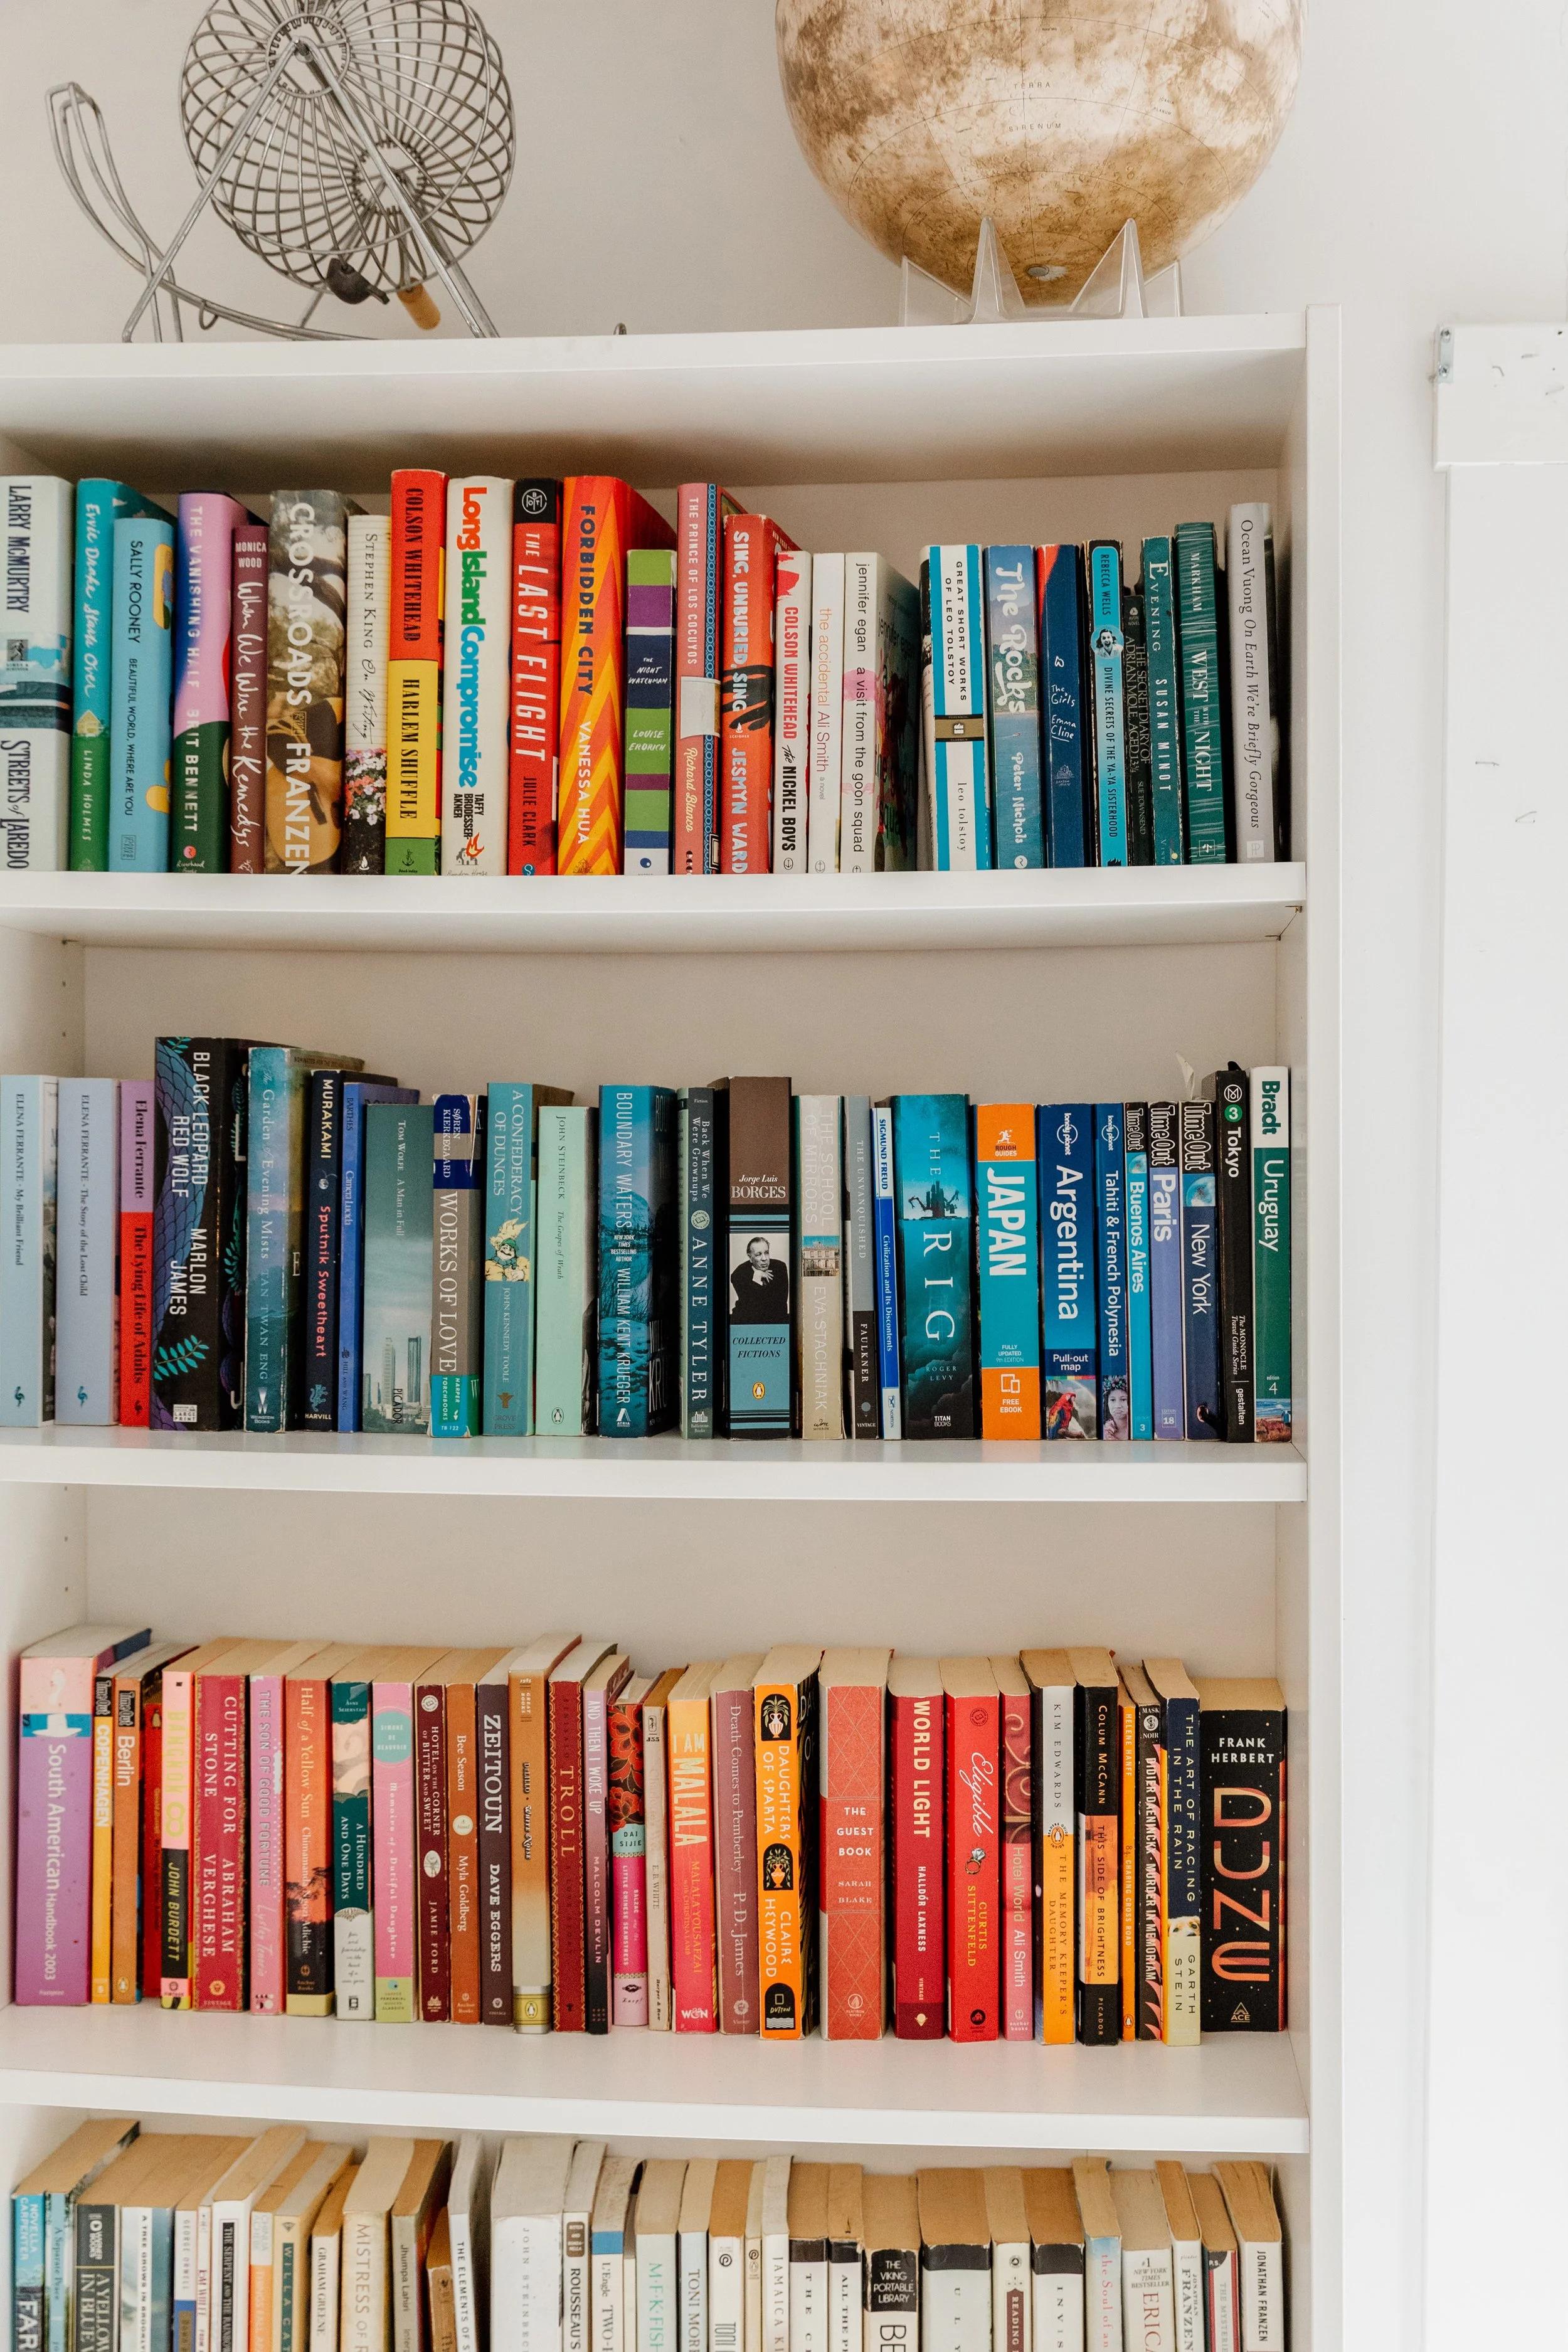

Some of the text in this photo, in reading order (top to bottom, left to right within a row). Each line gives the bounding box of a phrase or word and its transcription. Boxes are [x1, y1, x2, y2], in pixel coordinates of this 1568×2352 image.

[1014, 82, 1051, 90] TERRA
[1009, 123, 1061, 132] SIRENUM
[7, 485, 30, 529] LARRY
[235, 543, 267, 553] MONICA
[237, 558, 262, 568] WOOD
[945, 578, 952, 594] OF
[1239, 519, 1256, 615] Ocean Vuong
[127, 541, 143, 643] SALLY ROONEY
[287, 502, 315, 704] CROSSROADS
[578, 506, 595, 696] FORBIDDEN CITY
[731, 531, 749, 712] SING, UNBURIED, SING
[854, 563, 870, 652] jennifer egan
[956, 562, 967, 701] GREAT SHORT WORKS
[400, 488, 424, 819] COLSON WHITEHEAD HARLEM SHUFFLE
[515, 533, 549, 762] THE LAST FLIGHT
[946, 630, 955, 686] TOLSTOY
[995, 563, 1032, 714] The Rocks
[781, 607, 798, 851] COLSON WHITEHEAD The NICKEL BOYS
[816, 608, 832, 771] the accidental Ali Smith
[453, 793, 464, 818] AKNER
[462, 794, 474, 840] BRODESSER-
[474, 794, 484, 815] TAFFY
[577, 722, 592, 844] VANESSA HUA
[731, 748, 746, 874] JESMYN WARD
[1011, 752, 1025, 844] Peter Nichols
[191, 1052, 209, 1185] BLACK LEOPARD
[319, 1079, 334, 1158] MURAKAMI
[442, 1109, 451, 1178] KIERKEGAARD
[451, 1109, 463, 1139] SØREN
[556, 1116, 567, 1142] JOHN
[1261, 1081, 1281, 1135] Bradt
[172, 1116, 189, 1198] RED WOLF
[615, 1092, 632, 1229] BOUNDARY WATERS
[879, 1119, 889, 1190] SIGMUND FREUD
[928, 1132, 941, 1176] THE
[1224, 1127, 1242, 1177] Tokyo
[731, 1185, 786, 1199] BORGES
[987, 1167, 1027, 1276] JAPAN
[1152, 1173, 1177, 1242] Paris
[1258, 1160, 1283, 1252] Uruguay
[189, 1229, 208, 1295] MARLON
[1050, 1165, 1084, 1320] Argentina
[1130, 1181, 1147, 1293] Buenos Aires
[1190, 1223, 1211, 1315] New York
[169, 1261, 187, 1315] JAMES
[315, 1206, 331, 1357] Sputnik Sweetheart
[440, 1191, 458, 1372] WORKS OF LOVE
[691, 1237, 707, 1402] ANNE TYLER
[922, 1232, 956, 1342] RIG
[737, 1350, 780, 1359] FICTIONS
[859, 1323, 869, 1383] FAULKNER
[391, 1388, 403, 1424] PICADOR
[1236, 1388, 1246, 1424] gestalten
[117, 1735, 135, 1786] Berlin
[455, 1735, 468, 1791] Bee Season
[482, 1714, 502, 1833] ZEITOUN
[913, 1701, 931, 1838] WORLD LIGHT
[1053, 1703, 1062, 1809] KIM EDWARDS
[1211, 1754, 1274, 1763] HERBERT
[1219, 1738, 1266, 1747] FRANK
[558, 1766, 575, 1858] TROLL
[673, 1758, 707, 1846] MALALA
[763, 1752, 776, 1835] OF SPARTA
[778, 1745, 791, 1840] DAUGHTERS
[835, 1828, 874, 1836] GUEST
[844, 1807, 866, 1816] THE
[958, 1752, 994, 1837] Eligible
[167, 1863, 181, 1960] JOHN BURDETT
[457, 1855, 470, 1932] Myla Goldberg
[489, 1864, 502, 1972] DAVE EGGERS
[593, 1857, 602, 1963] MALCOLM DEVLIN
[916, 1866, 929, 1952] HALLDÓR LAXNESS
[967, 1886, 977, 1966] SITTENFELD
[978, 1902, 988, 1950] CURTIS
[765, 1899, 778, 1978] HEYWOOD
[780, 1911, 792, 1964] CLAIRE
[1174, 1958, 1183, 2011] STEIN
[1187, 1954, 1195, 2014] GARTH
[400, 2245, 409, 2282] Jhumpa
[458, 2267, 469, 2321] ELEMENTS
[1257, 2251, 1268, 2341] JONATHAN FRANZEN
[462, 2327, 470, 2339] OF
